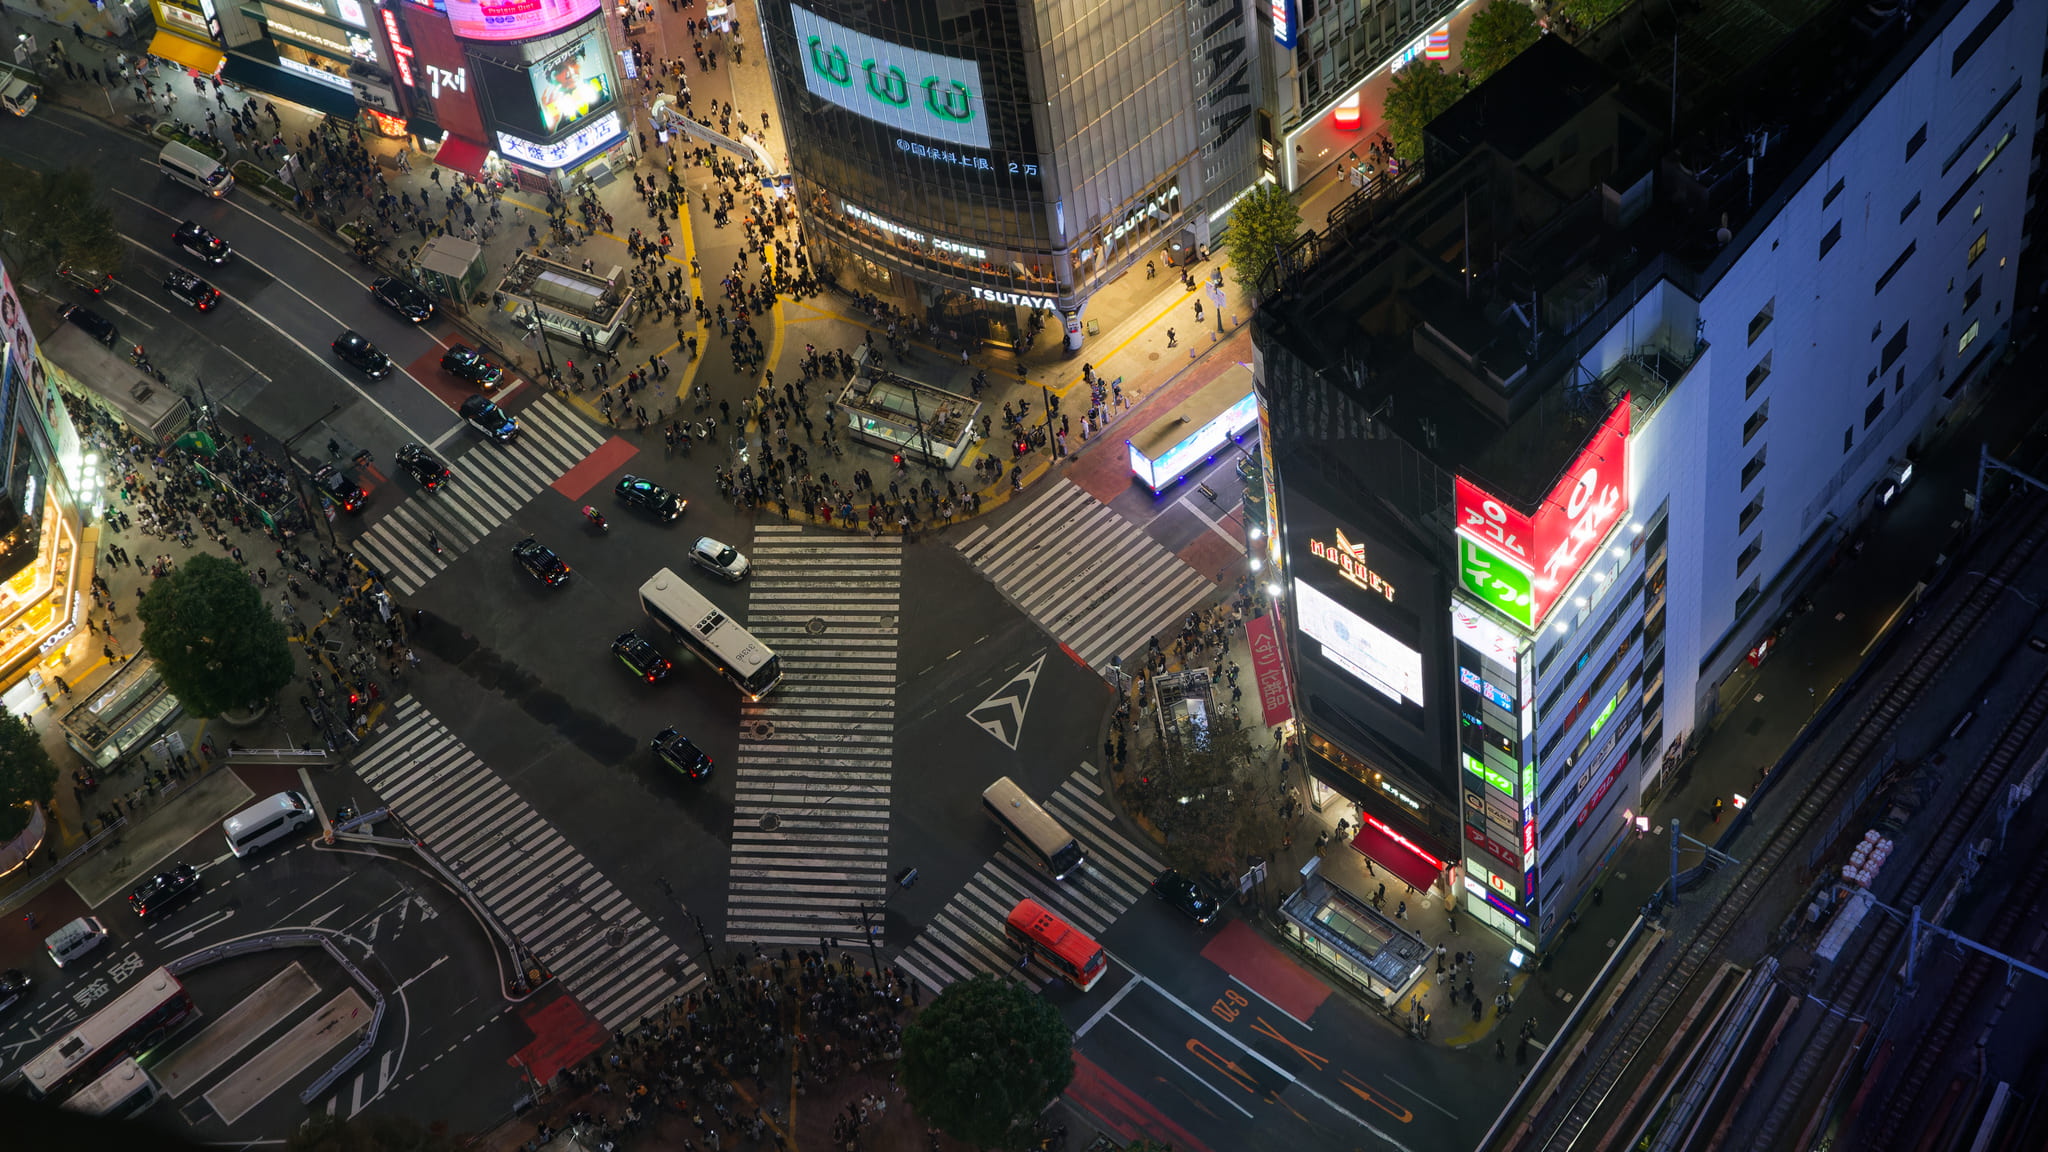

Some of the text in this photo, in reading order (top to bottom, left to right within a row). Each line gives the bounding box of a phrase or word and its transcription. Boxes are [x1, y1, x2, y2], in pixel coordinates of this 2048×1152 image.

[845, 203, 986, 259] STARBUCKS COFFEE
[1103, 186, 1180, 246] TSUTAYA
[971, 286, 1057, 310] TSUTAYA
[1465, 506, 1526, 557] アコム
[1309, 537, 1396, 602] MAGNET
[1254, 633, 1286, 711] くすり 化粧品
[1470, 760, 1511, 789] レイク
[1471, 830, 1514, 865] アコム
[2, 952, 144, 1060] 路線バス
[1211, 989, 1249, 1022] 8-20
